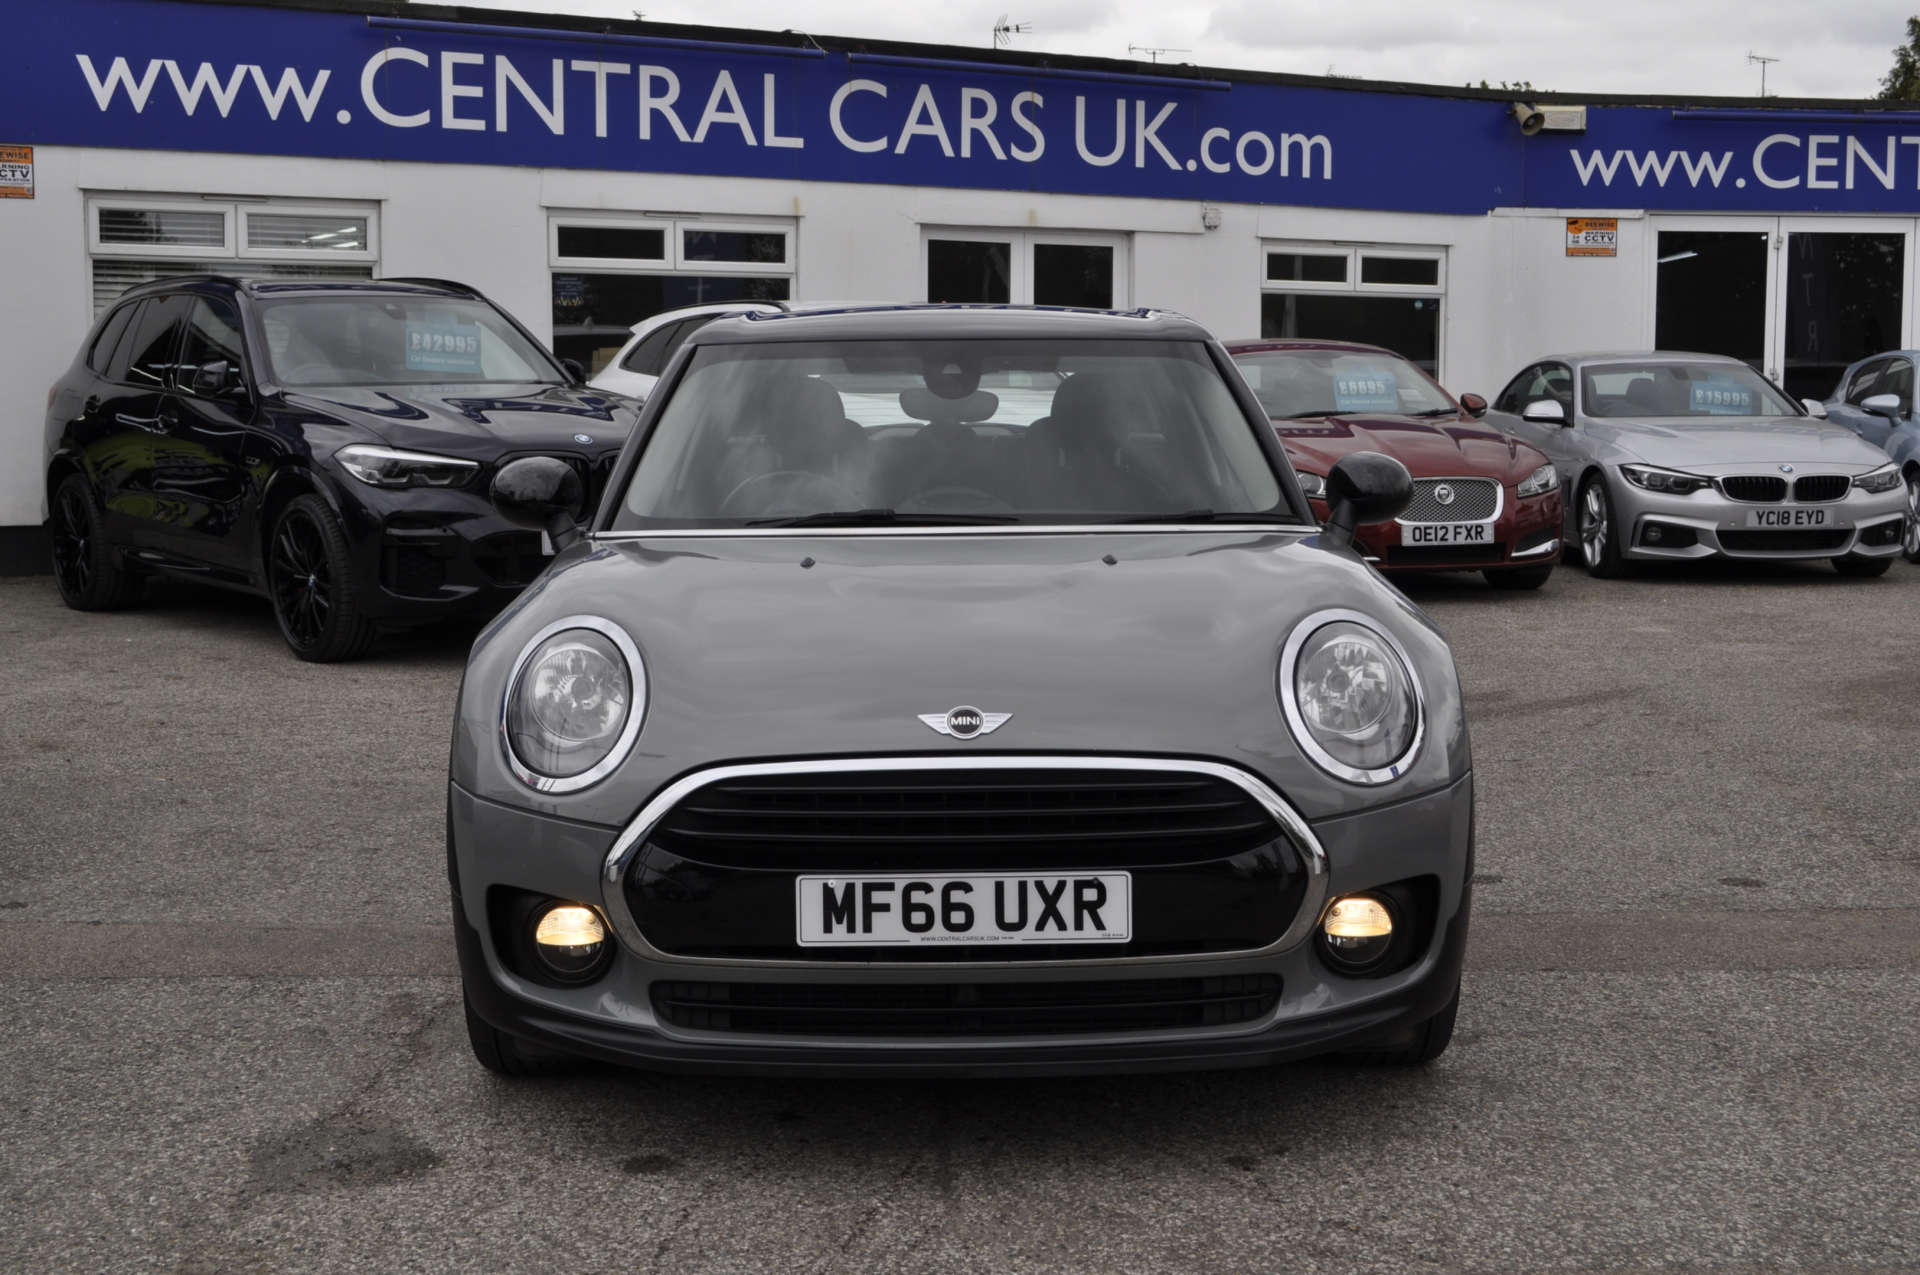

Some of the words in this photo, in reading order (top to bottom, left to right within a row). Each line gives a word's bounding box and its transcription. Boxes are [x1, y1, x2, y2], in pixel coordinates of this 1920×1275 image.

[76, 47, 803, 149] www.CENTRAL
[829, 79, 1045, 163] CARS
[1075, 95, 1332, 180] UK.com
[1755, 510, 1791, 526] YC18
[1794, 509, 1825, 526] EYD
[1412, 526, 1449, 543] OE12
[1453, 525, 1485, 542] FXR
[950, 716, 981, 726] MINI
[822, 881, 975, 934] MF66
[994, 878, 1107, 932] UXR
